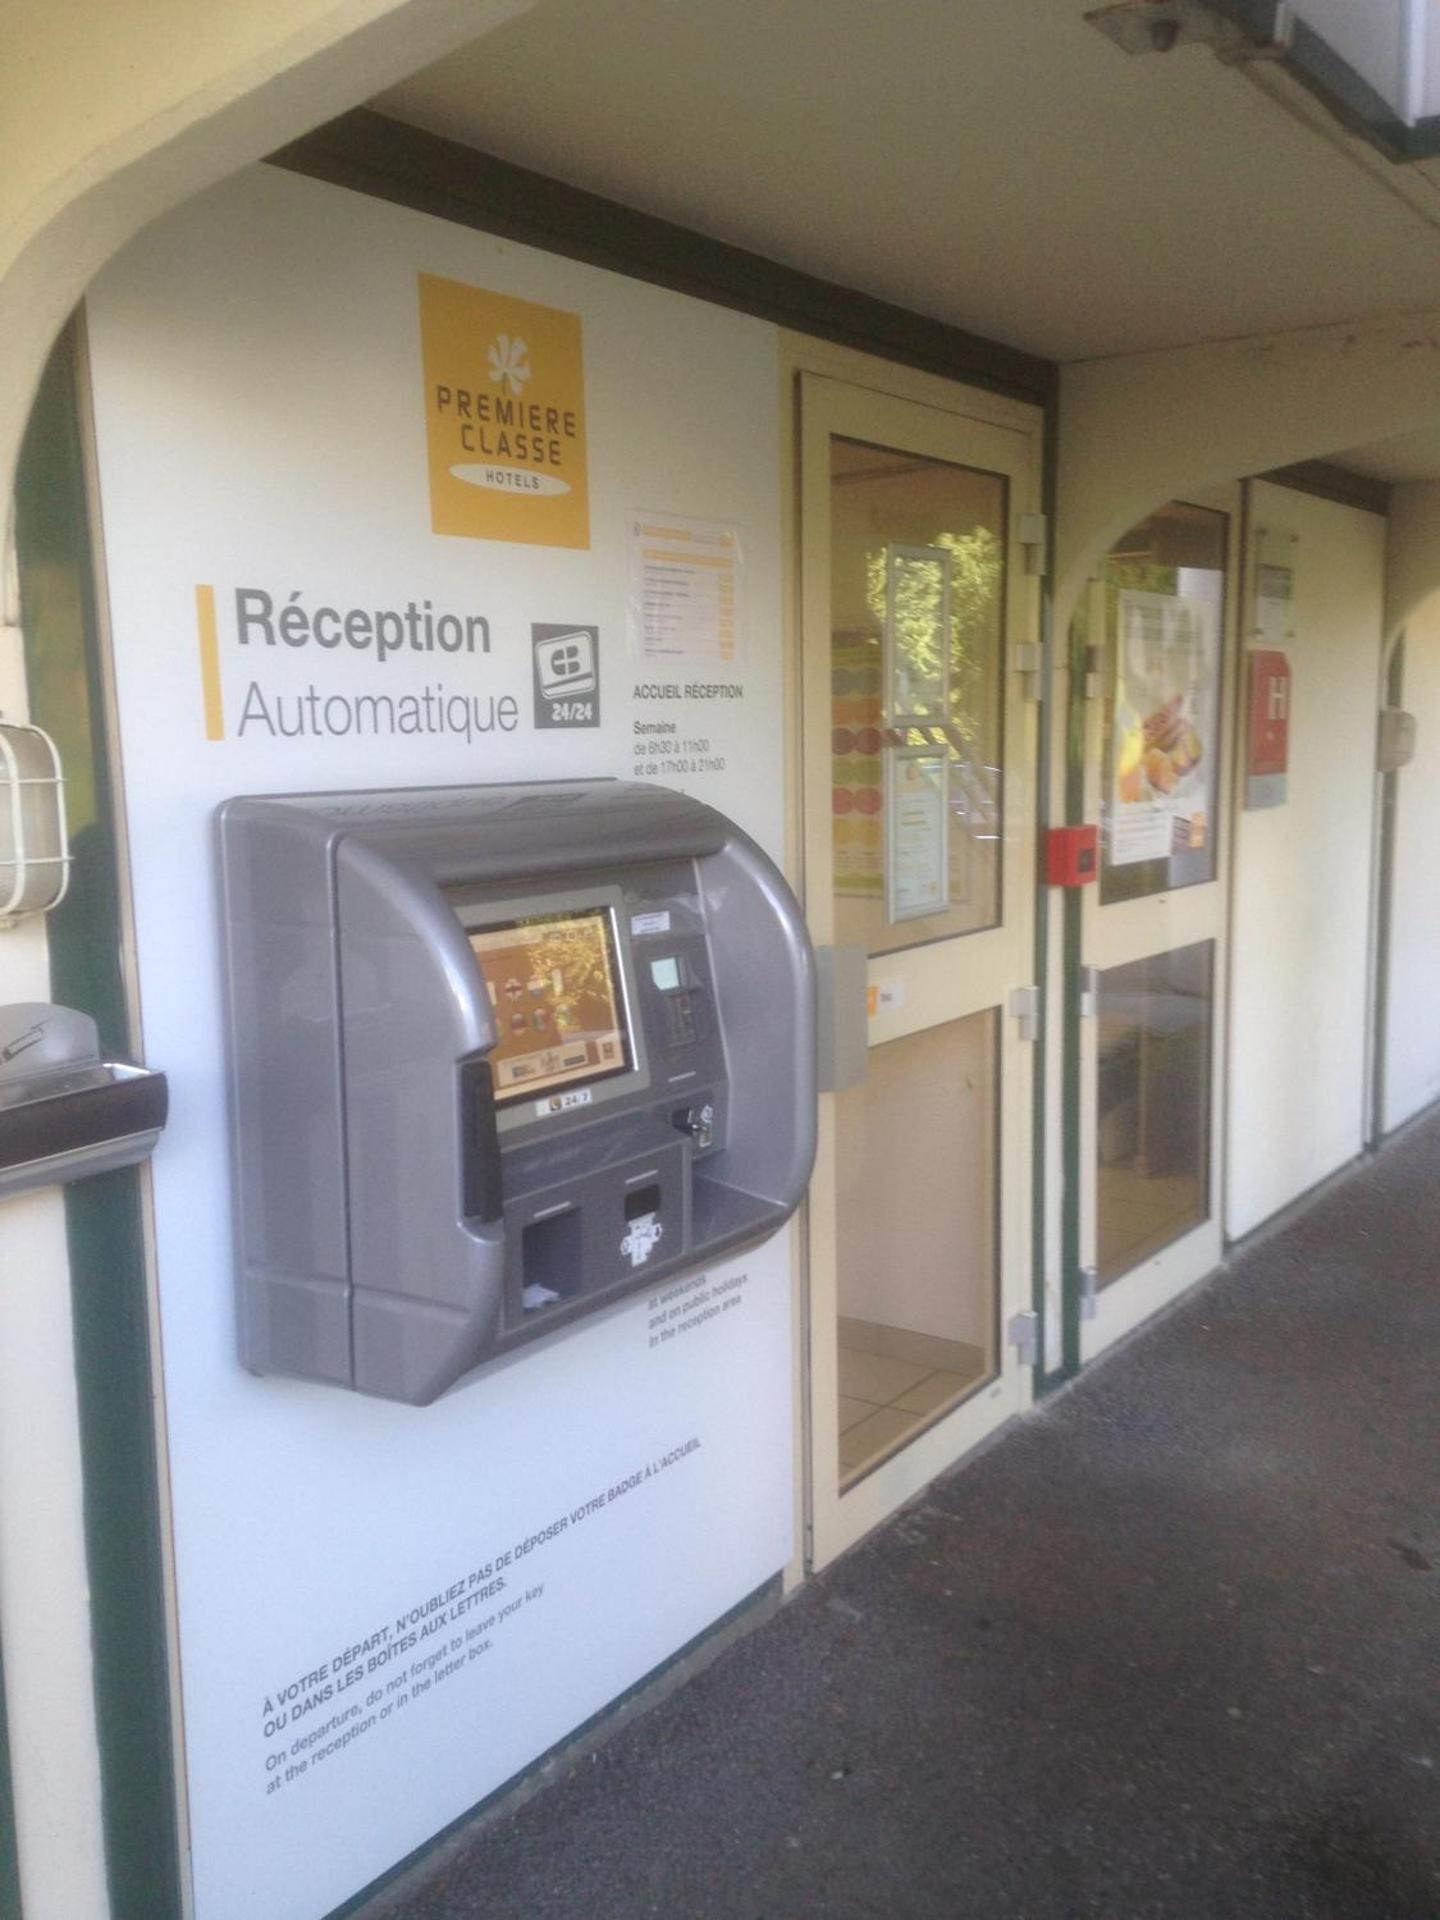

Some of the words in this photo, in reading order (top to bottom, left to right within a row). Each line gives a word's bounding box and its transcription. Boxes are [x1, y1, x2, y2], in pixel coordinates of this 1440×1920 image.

[436, 385, 576, 438] PREMIERE
[460, 424, 562, 466] CLASSE
[485, 469, 540, 490] HOTELS
[235, 587, 491, 662] Réception
[237, 680, 519, 744] Automatique
[552, 702, 592, 721] 24/24
[633, 684, 682, 699] ACCUEIL
[684, 681, 743, 699] RÉCEPTION
[633, 720, 676, 735] Semaine
[277, 1665, 329, 1707] VOTRE
[332, 1626, 393, 1673] DÉPART,
[396, 1581, 466, 1633] N'OUBLIEZ
[469, 1563, 493, 1588] PAS
[495, 1550, 512, 1571] DE
[514, 1517, 568, 1560] DÉPOSER
[569, 1493, 606, 1525] VOTRE
[607, 1470, 643, 1502] BADGE
[263, 1713, 287, 1738] OU
[291, 1685, 333, 1722] DANS
[337, 1665, 364, 1692] LES
[367, 1631, 417, 1674] BOÎTES
[419, 1613, 447, 1640] AUX
[450, 1576, 507, 1621] LETTRES.
[265, 1751, 287, 1772] On
[290, 1703, 363, 1757] departure,
[365, 1687, 384, 1707] do
[386, 1672, 408, 1694] not
[410, 1644, 448, 1681] forget
[450, 1634, 464, 1649] to
[465, 1613, 495, 1639] leave
[497, 1596, 524, 1623] your
[525, 1582, 545, 1601] key
[266, 1776, 281, 1795] at
[285, 1759, 308, 1782] the
[311, 1714, 376, 1766] reception
[380, 1701, 395, 1720] or
[397, 1693, 408, 1709] in
[411, 1679, 432, 1698] the
[434, 1654, 466, 1684] letter
[468, 1640, 493, 1660] box.
